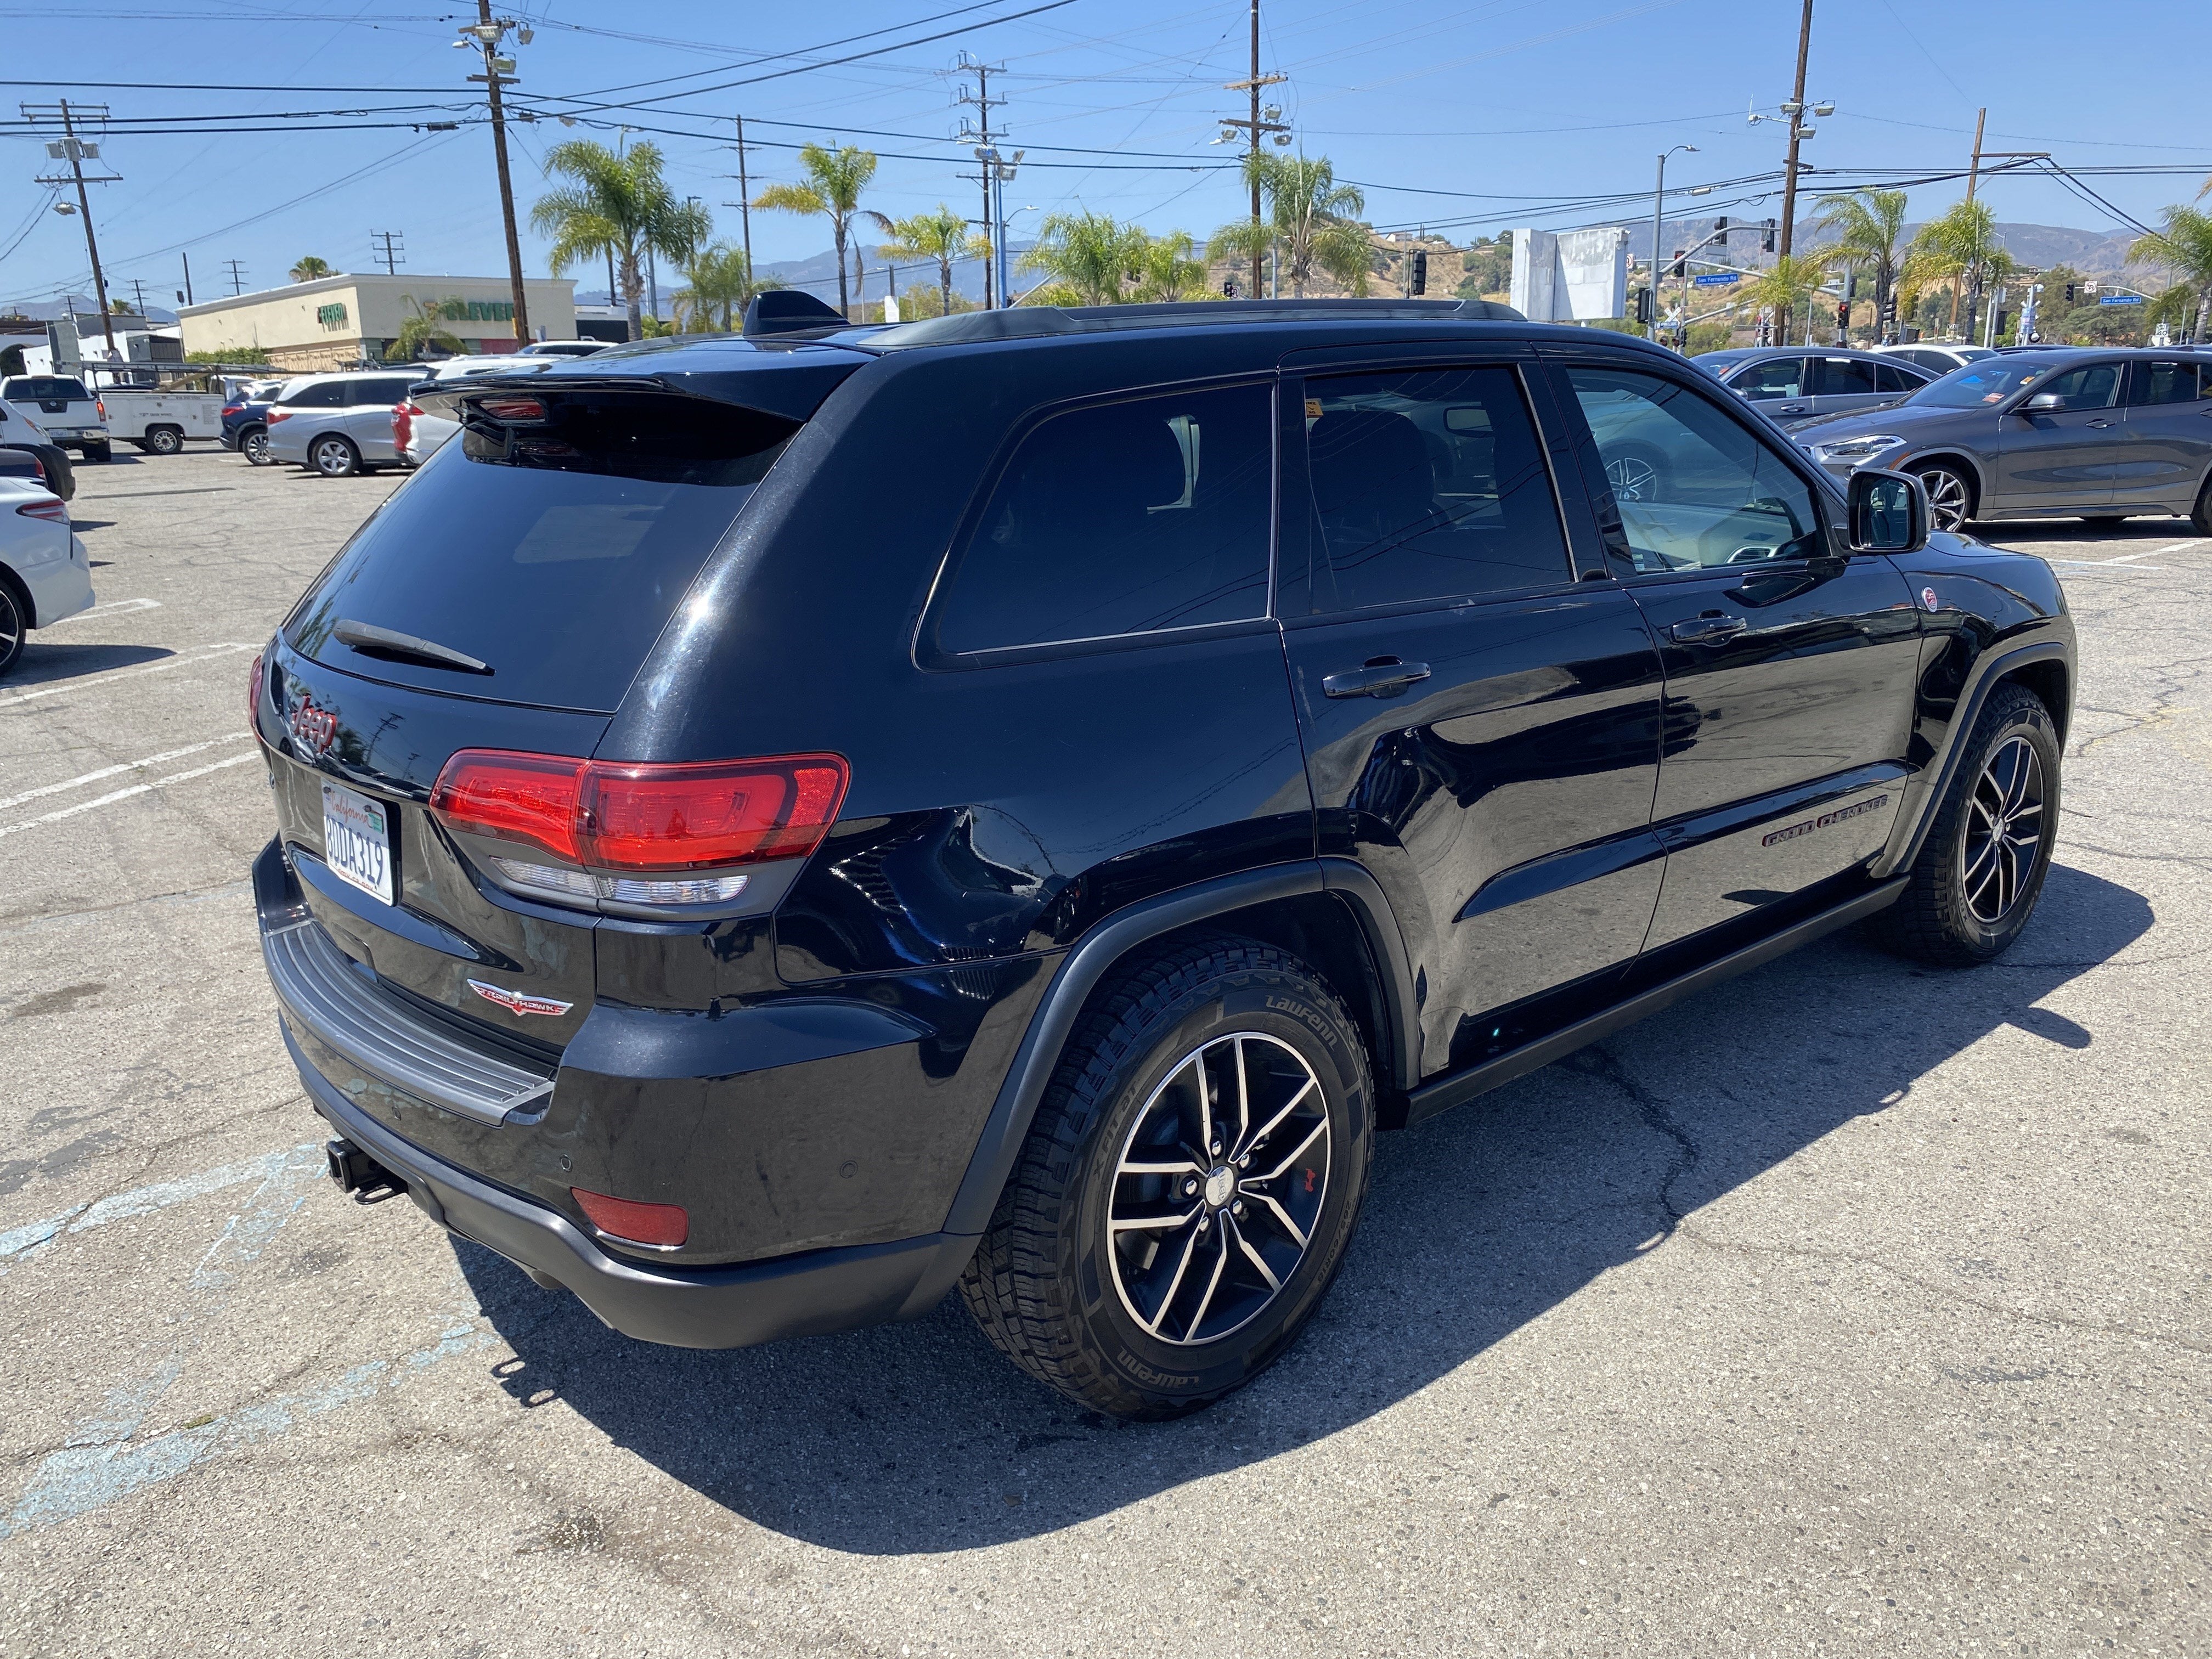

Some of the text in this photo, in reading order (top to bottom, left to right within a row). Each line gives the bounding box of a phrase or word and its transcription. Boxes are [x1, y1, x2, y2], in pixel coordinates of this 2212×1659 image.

[290, 693, 338, 755] Jeep
[331, 790, 369, 823] California
[1762, 794, 1888, 847] GRAND CHEROKEE
